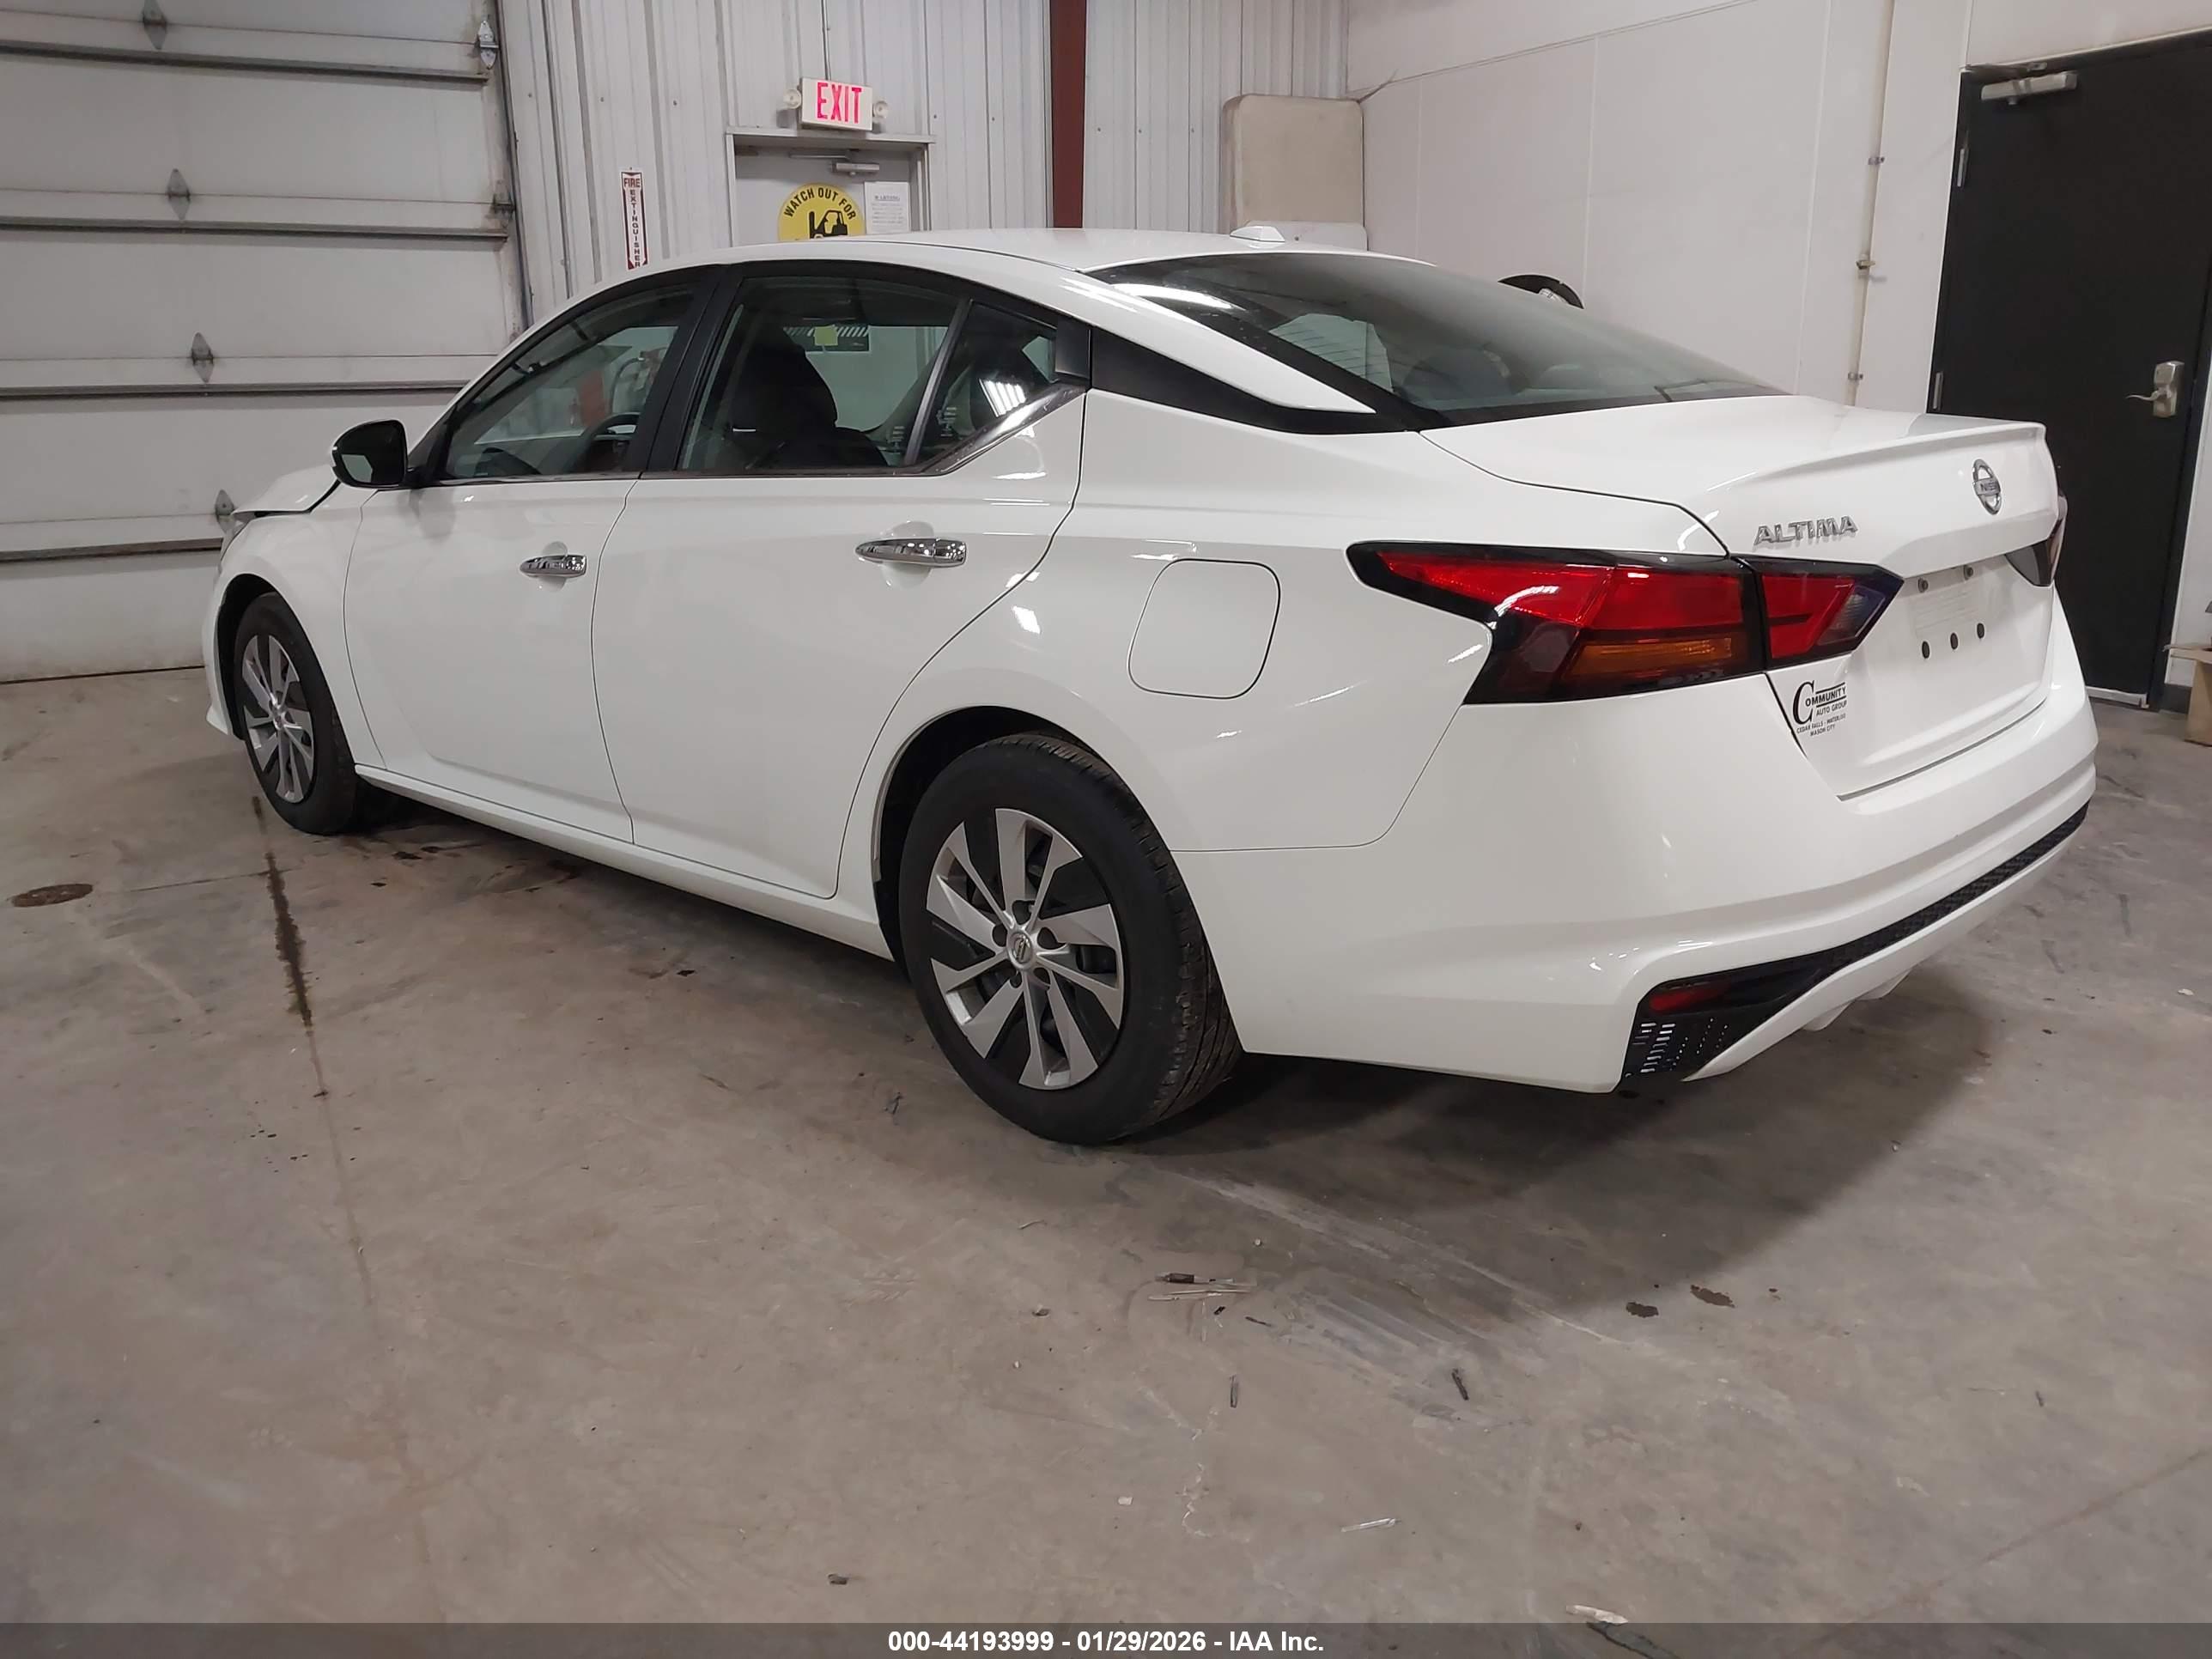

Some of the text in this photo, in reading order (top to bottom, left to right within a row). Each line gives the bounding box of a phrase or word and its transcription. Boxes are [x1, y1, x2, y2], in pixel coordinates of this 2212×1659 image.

[817, 82, 862, 125] EXIT
[623, 178, 641, 188] FIRE
[783, 187, 815, 217] WATCH
[817, 187, 839, 202] OUT
[838, 198, 857, 220] FOR
[629, 189, 641, 268] EXTINGUISHER
[1753, 516, 1858, 545] ALTIMA
[1816, 700, 1847, 716] AUTO GROUP
[1810, 727, 1826, 736] MASON
